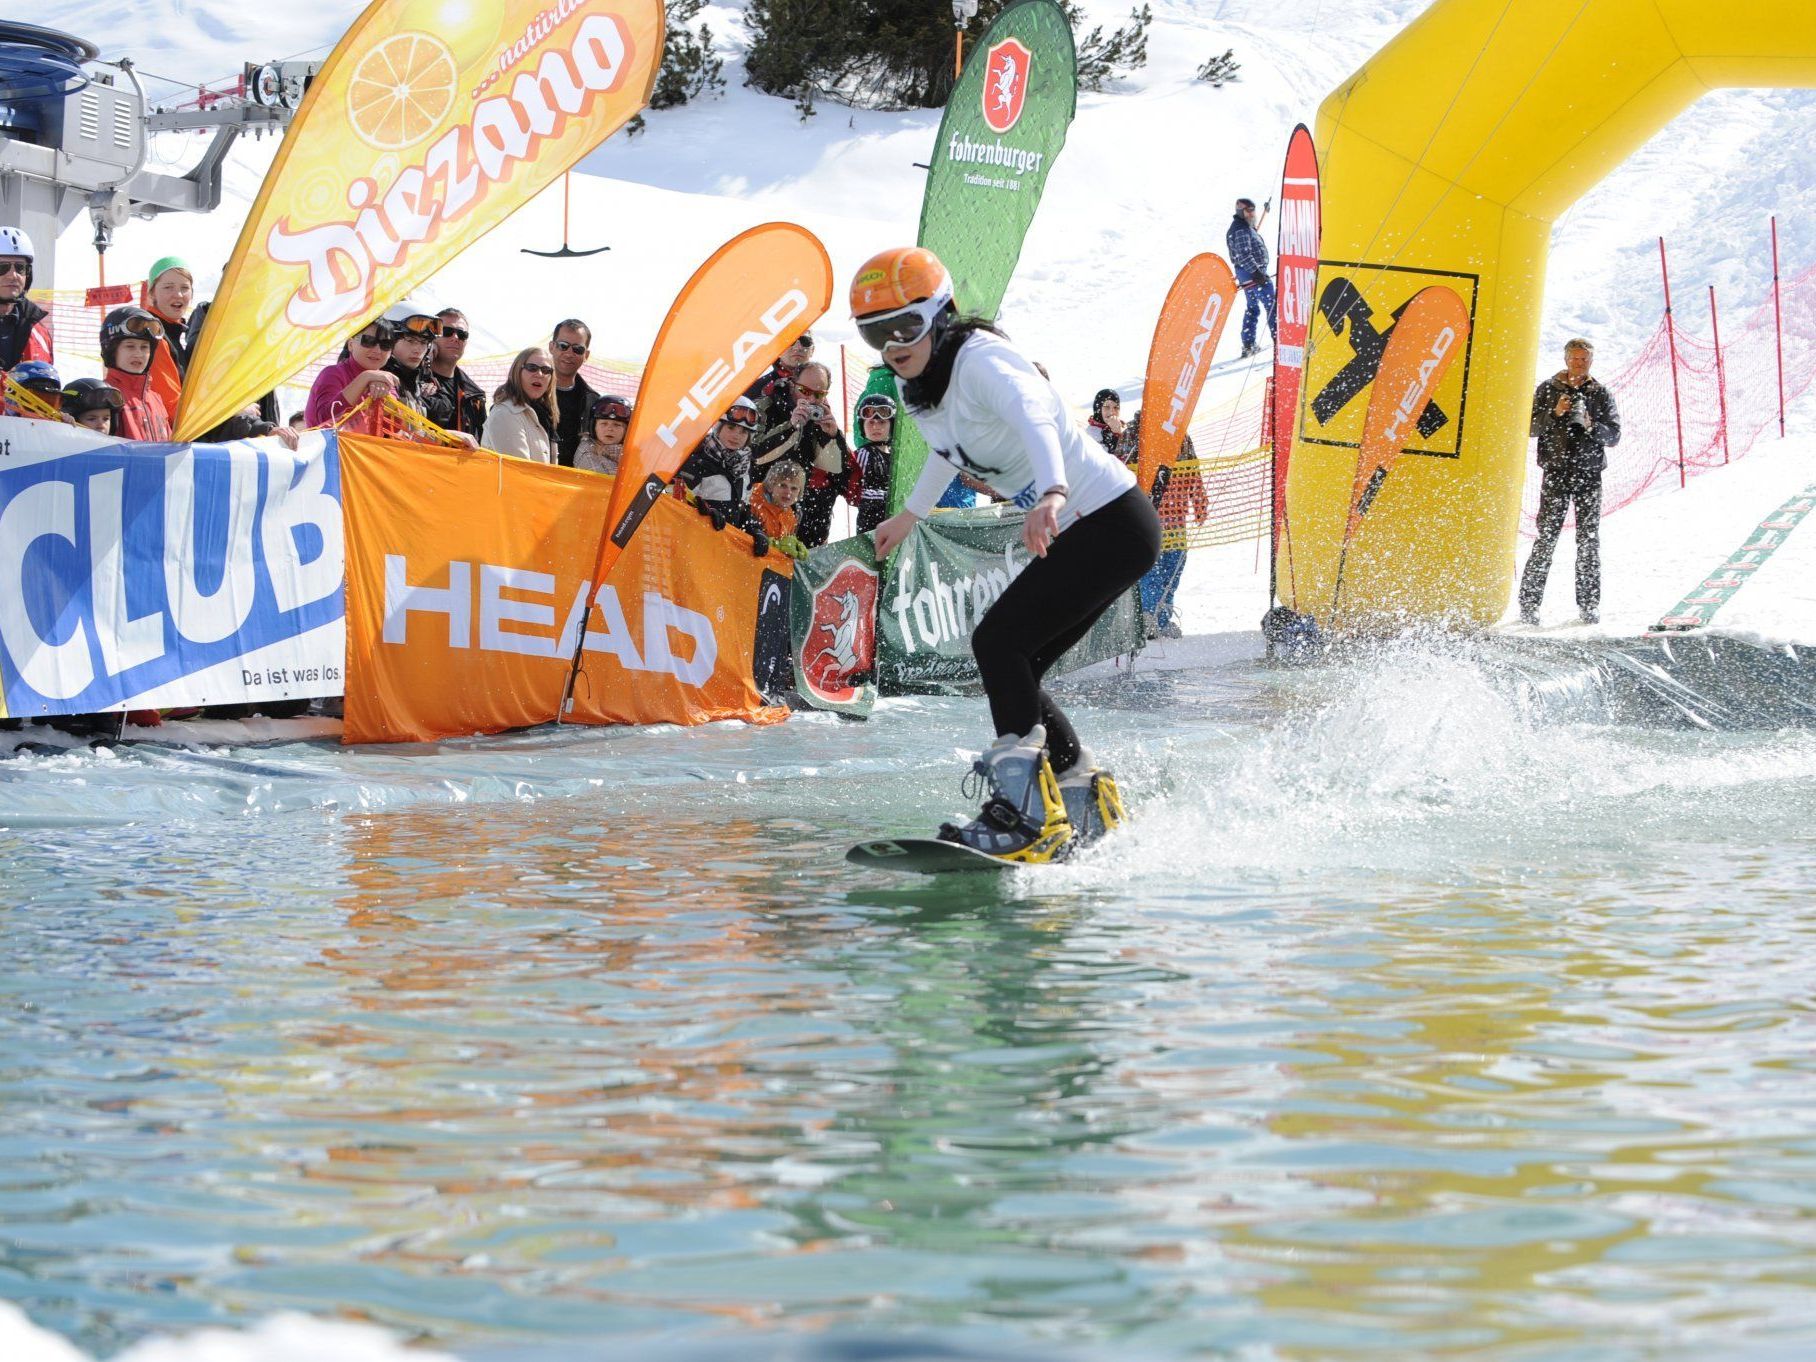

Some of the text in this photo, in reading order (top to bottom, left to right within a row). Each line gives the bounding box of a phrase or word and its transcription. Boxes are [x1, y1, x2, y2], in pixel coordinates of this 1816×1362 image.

[266, 14, 630, 329] Diezano
[963, 173, 992, 187] Tradition
[992, 177, 1005, 189] seit
[656, 288, 809, 449] HEAD
[1161, 292, 1222, 437] HEAD
[1384, 326, 1456, 443] HEAD
[0, 430, 345, 700] CLUB
[382, 553, 718, 689] HEAD
[891, 542, 1031, 654] fohrenb
[242, 664, 342, 686] Da ist was los.
